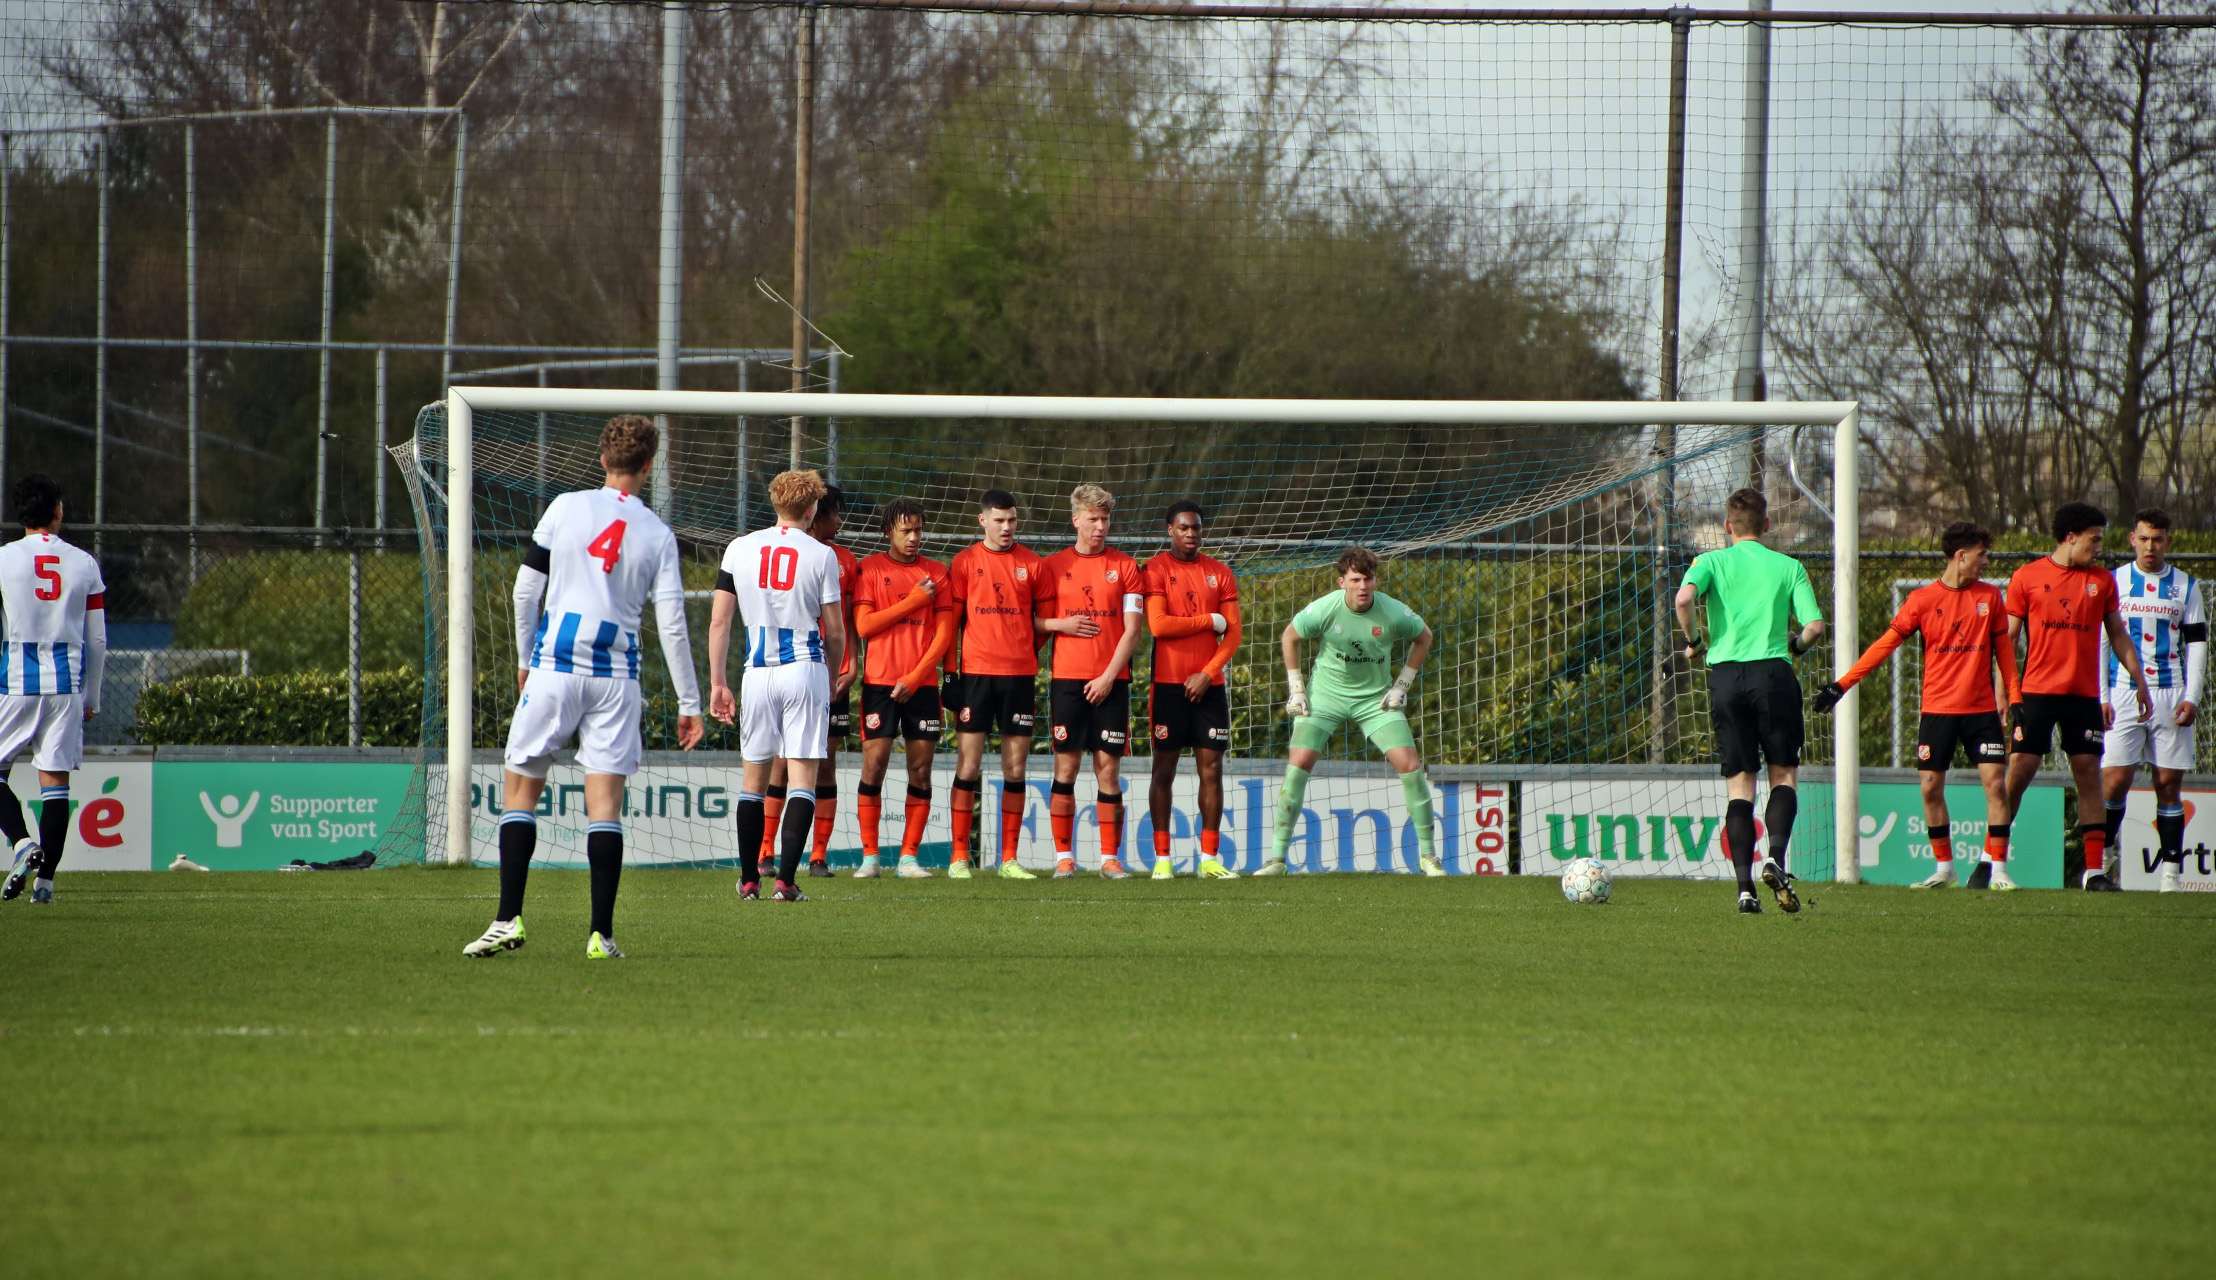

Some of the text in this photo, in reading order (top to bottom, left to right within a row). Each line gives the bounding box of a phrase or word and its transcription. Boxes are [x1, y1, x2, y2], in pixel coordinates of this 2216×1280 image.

[587, 519, 627, 574] 4
[759, 545, 799, 591] 10
[34, 555, 61, 600] 5
[2131, 603, 2179, 616] Ausnutria
[270, 794, 378, 818] Supporter
[270, 819, 377, 843] van Sport
[1476, 782, 1504, 876] POST
